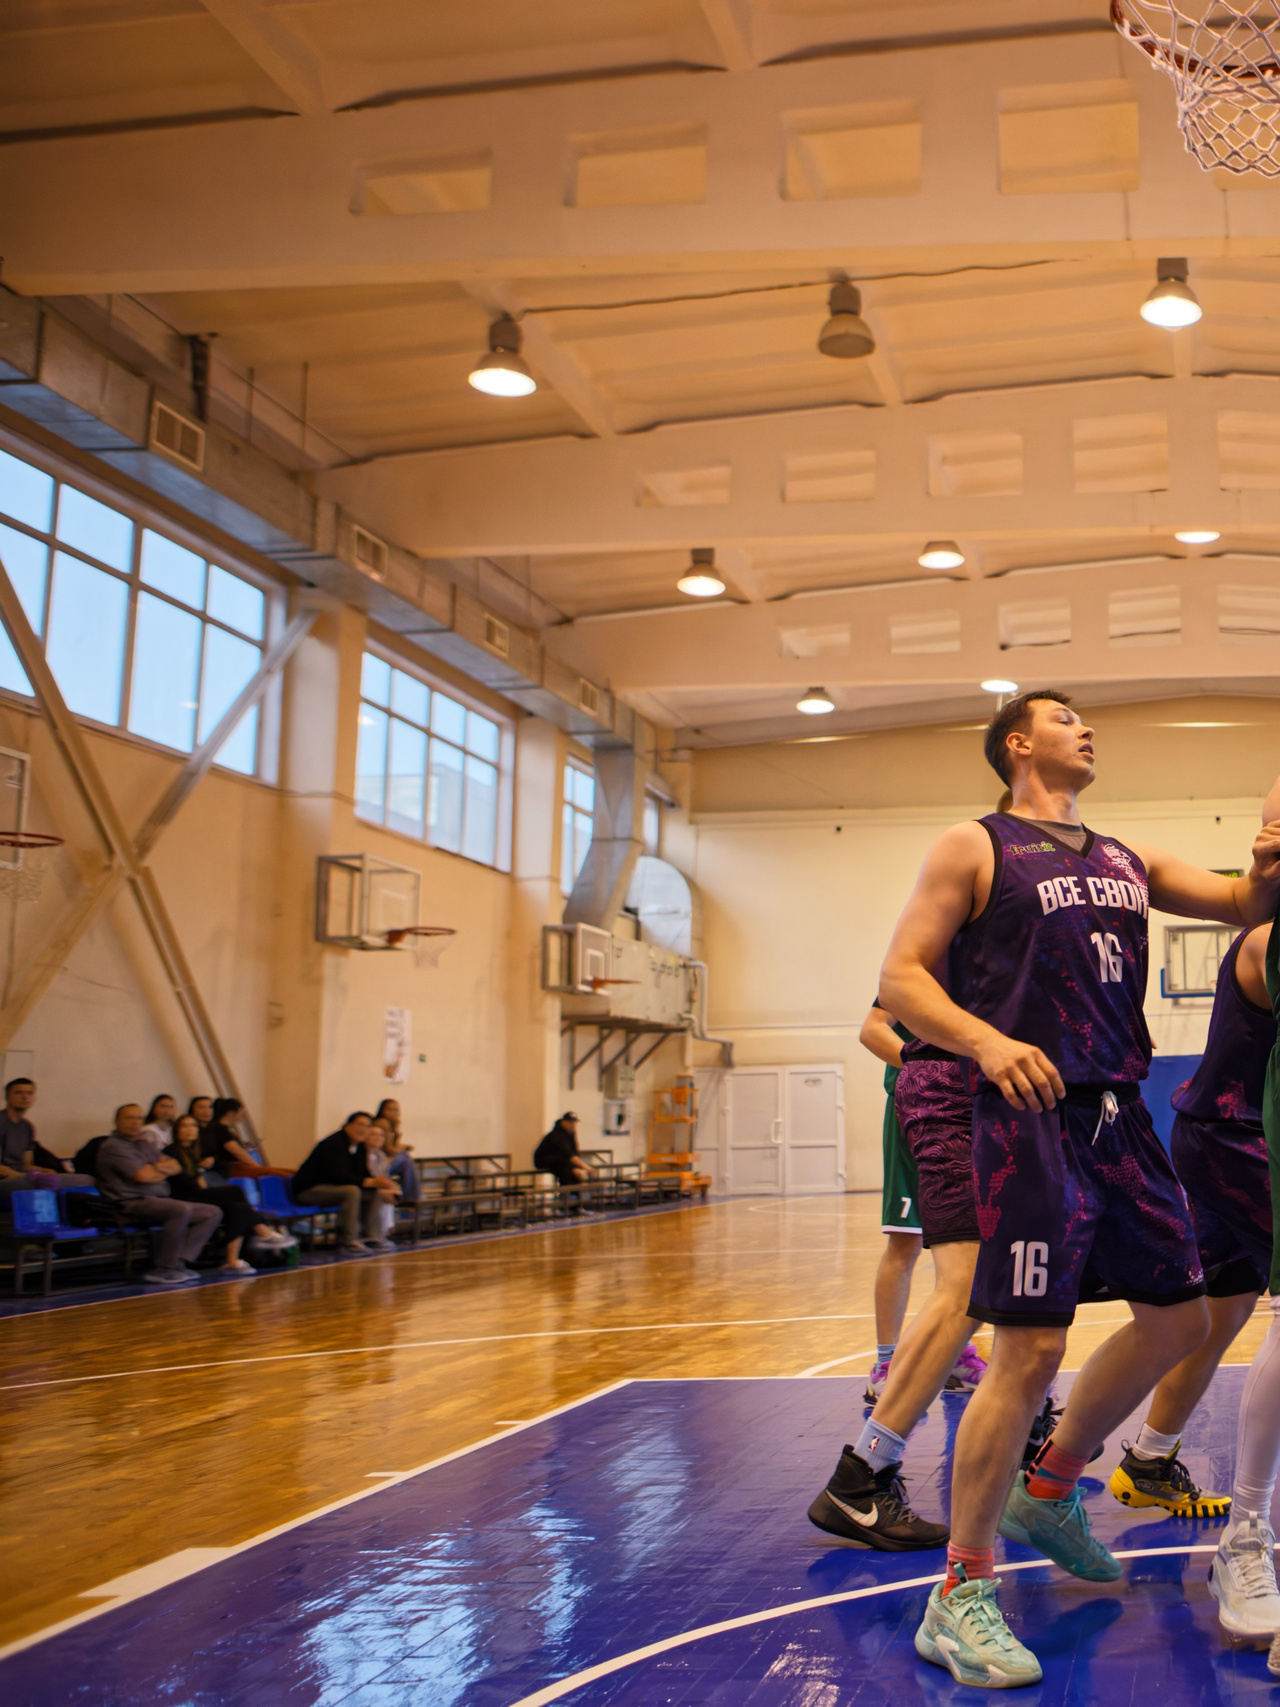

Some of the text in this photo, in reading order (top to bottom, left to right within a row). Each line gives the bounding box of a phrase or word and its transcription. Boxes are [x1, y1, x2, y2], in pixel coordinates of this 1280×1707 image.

[1036, 876, 1087, 916] ВСЕ
[1090, 932, 1124, 983] 16
[900, 1196, 912, 1218] 7
[1010, 1240, 1049, 1297] 16
